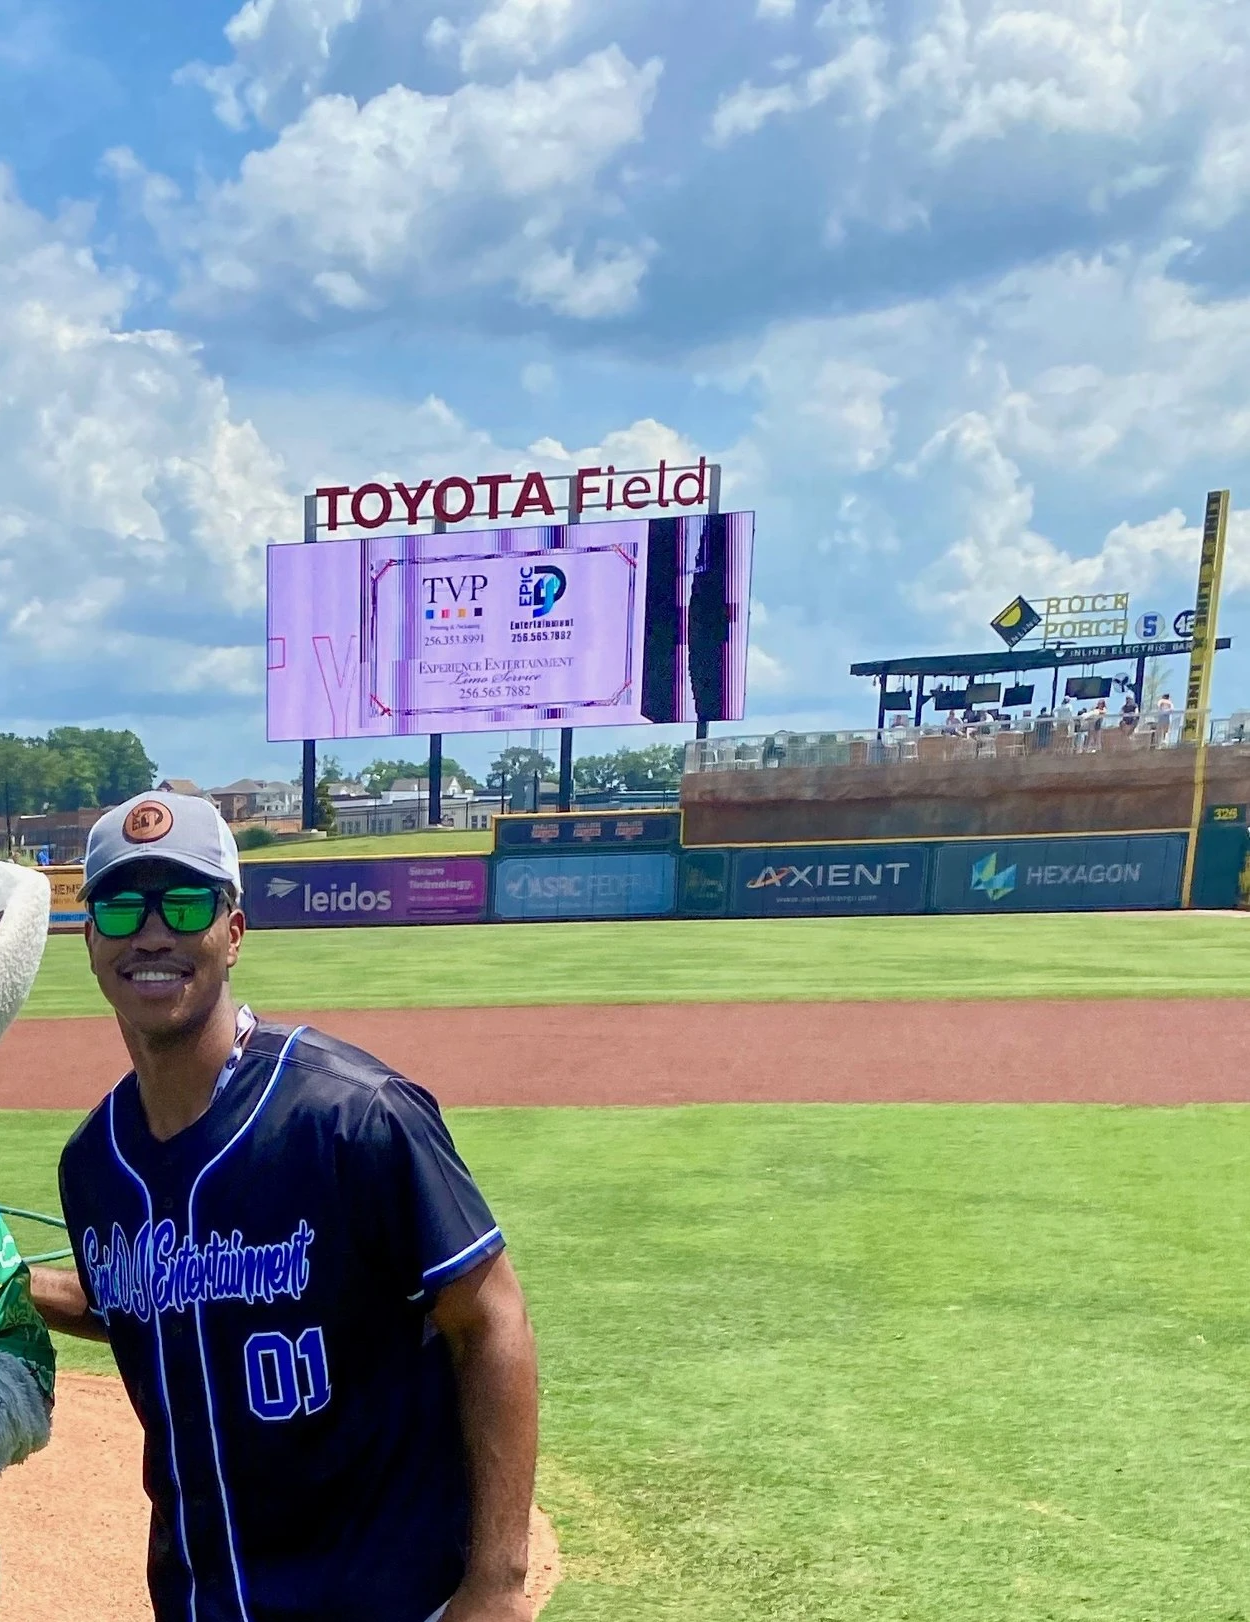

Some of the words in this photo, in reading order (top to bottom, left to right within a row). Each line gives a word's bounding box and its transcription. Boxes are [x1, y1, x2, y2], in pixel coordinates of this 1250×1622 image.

[316, 471, 555, 531] TOYOTA
[576, 456, 707, 513] Field
[422, 574, 488, 604] TVP
[518, 566, 534, 607] EPIC
[1046, 594, 1128, 614] ROCK
[510, 618, 574, 630] Entertainment
[1045, 620, 1128, 640] PORCH
[1143, 615, 1158, 637] 5
[1111, 643, 1166, 655] ELECTRIC
[419, 660, 482, 675] EXPERIENCE
[484, 656, 574, 672] ENTERTAINMENT
[491, 670, 542, 684] Service
[753, 862, 911, 888] AXIENT
[1025, 863, 1143, 886] HEXAGON
[303, 882, 392, 913] leidos
[530, 875, 583, 898] ASRC
[244, 1326, 333, 1421] 01
